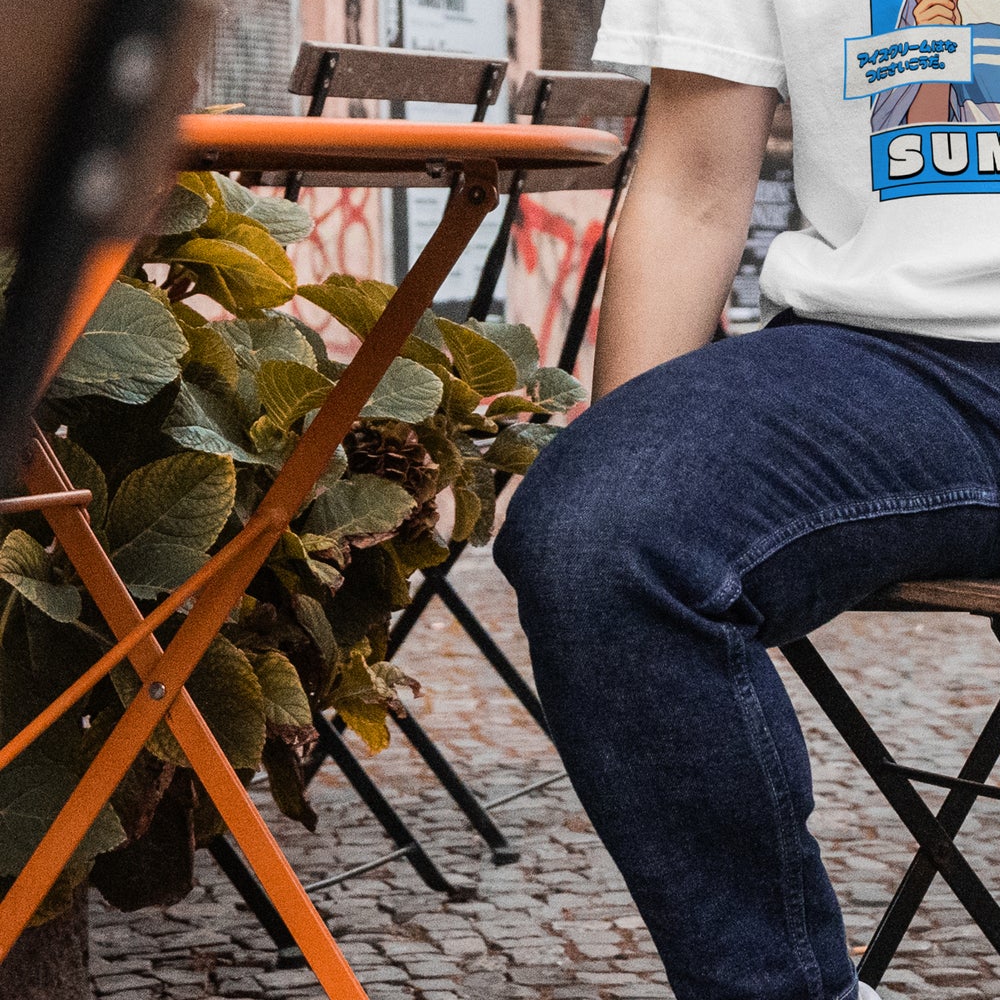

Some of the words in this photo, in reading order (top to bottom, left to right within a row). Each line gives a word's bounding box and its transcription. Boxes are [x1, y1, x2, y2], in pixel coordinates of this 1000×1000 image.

[857, 40, 958, 68] アイスクリームはな
